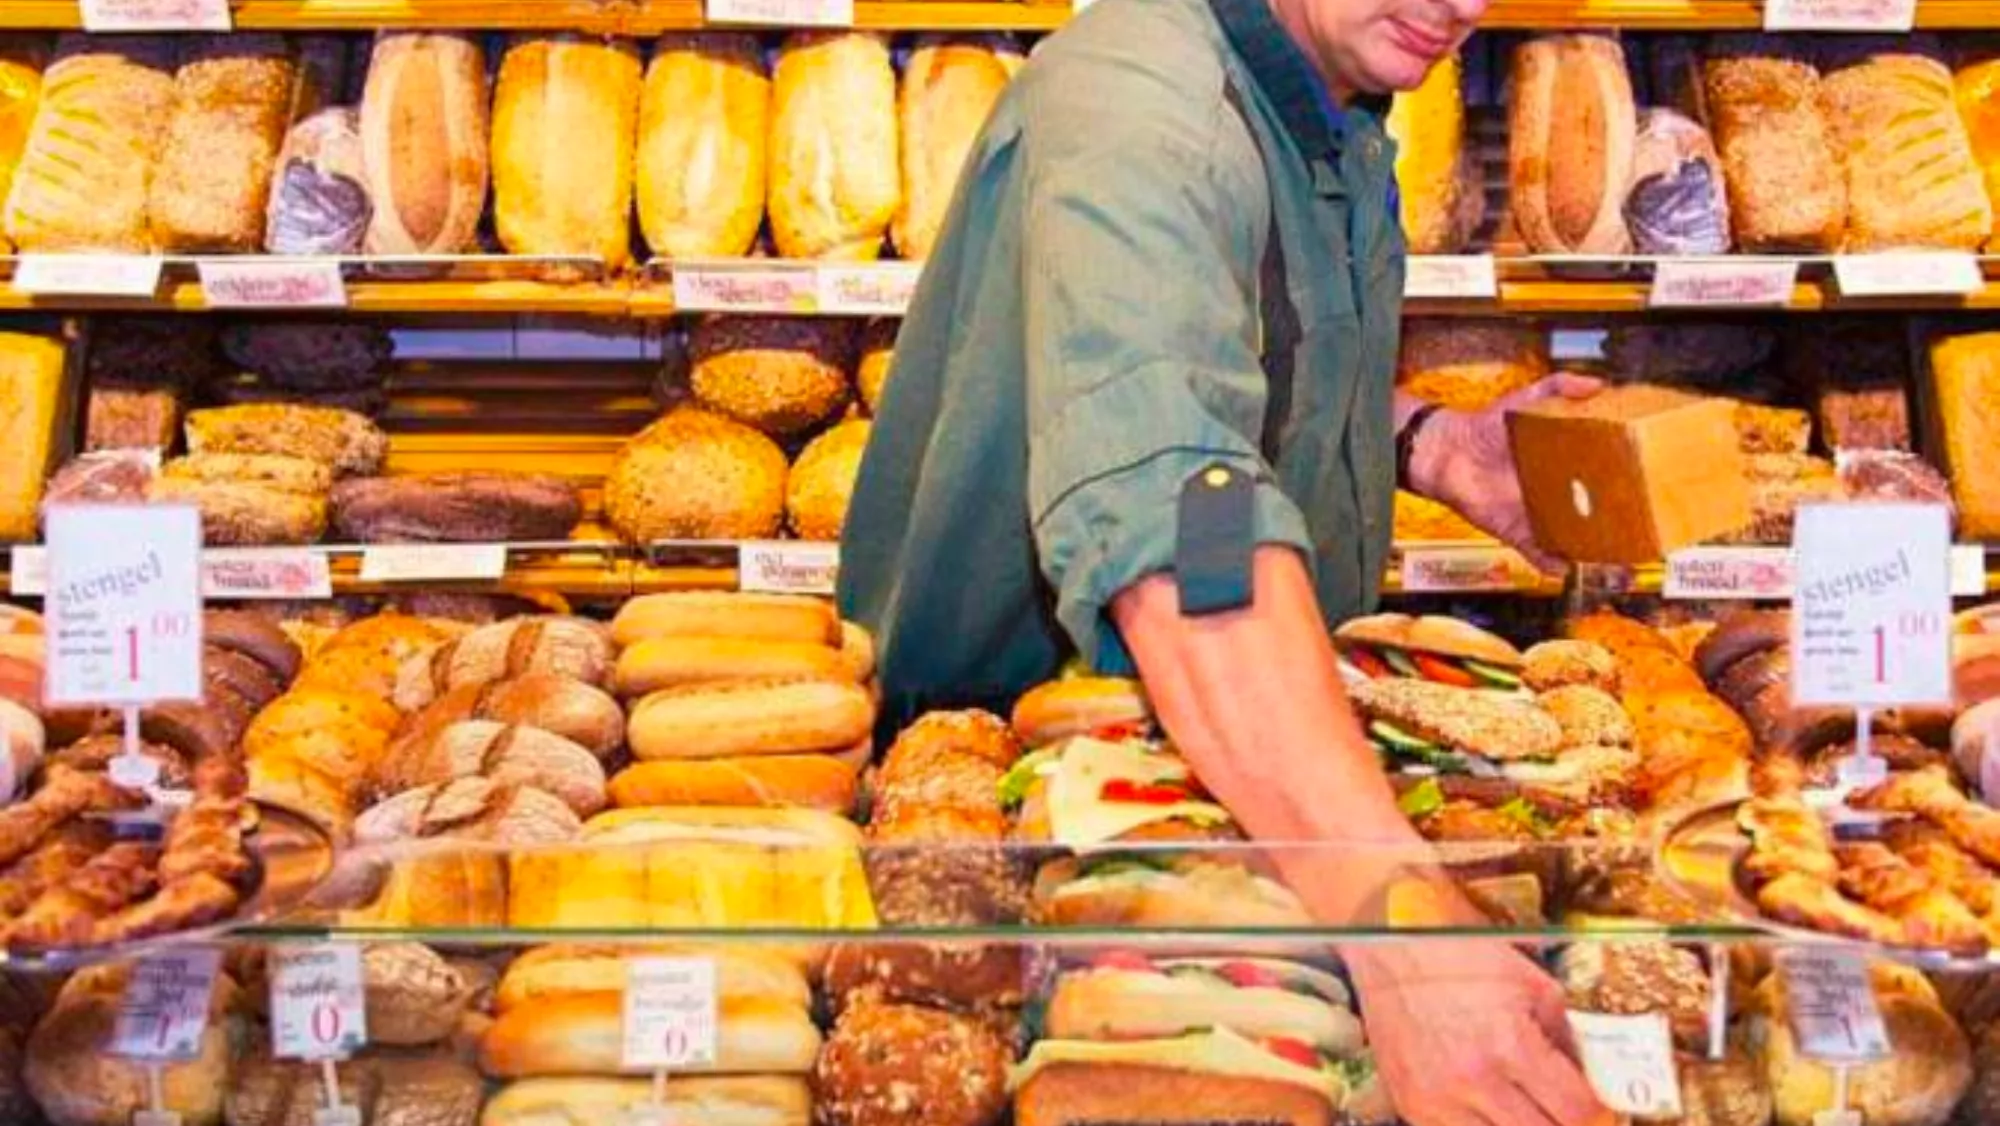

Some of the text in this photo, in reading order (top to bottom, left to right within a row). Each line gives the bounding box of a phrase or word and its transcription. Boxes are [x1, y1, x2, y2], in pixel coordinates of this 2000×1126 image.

[57, 549, 162, 603] stengel
[1802, 547, 1911, 601] stengel
[126, 626, 138, 681] 1
[1873, 625, 1885, 682] 1
[311, 1003, 339, 1045] 0
